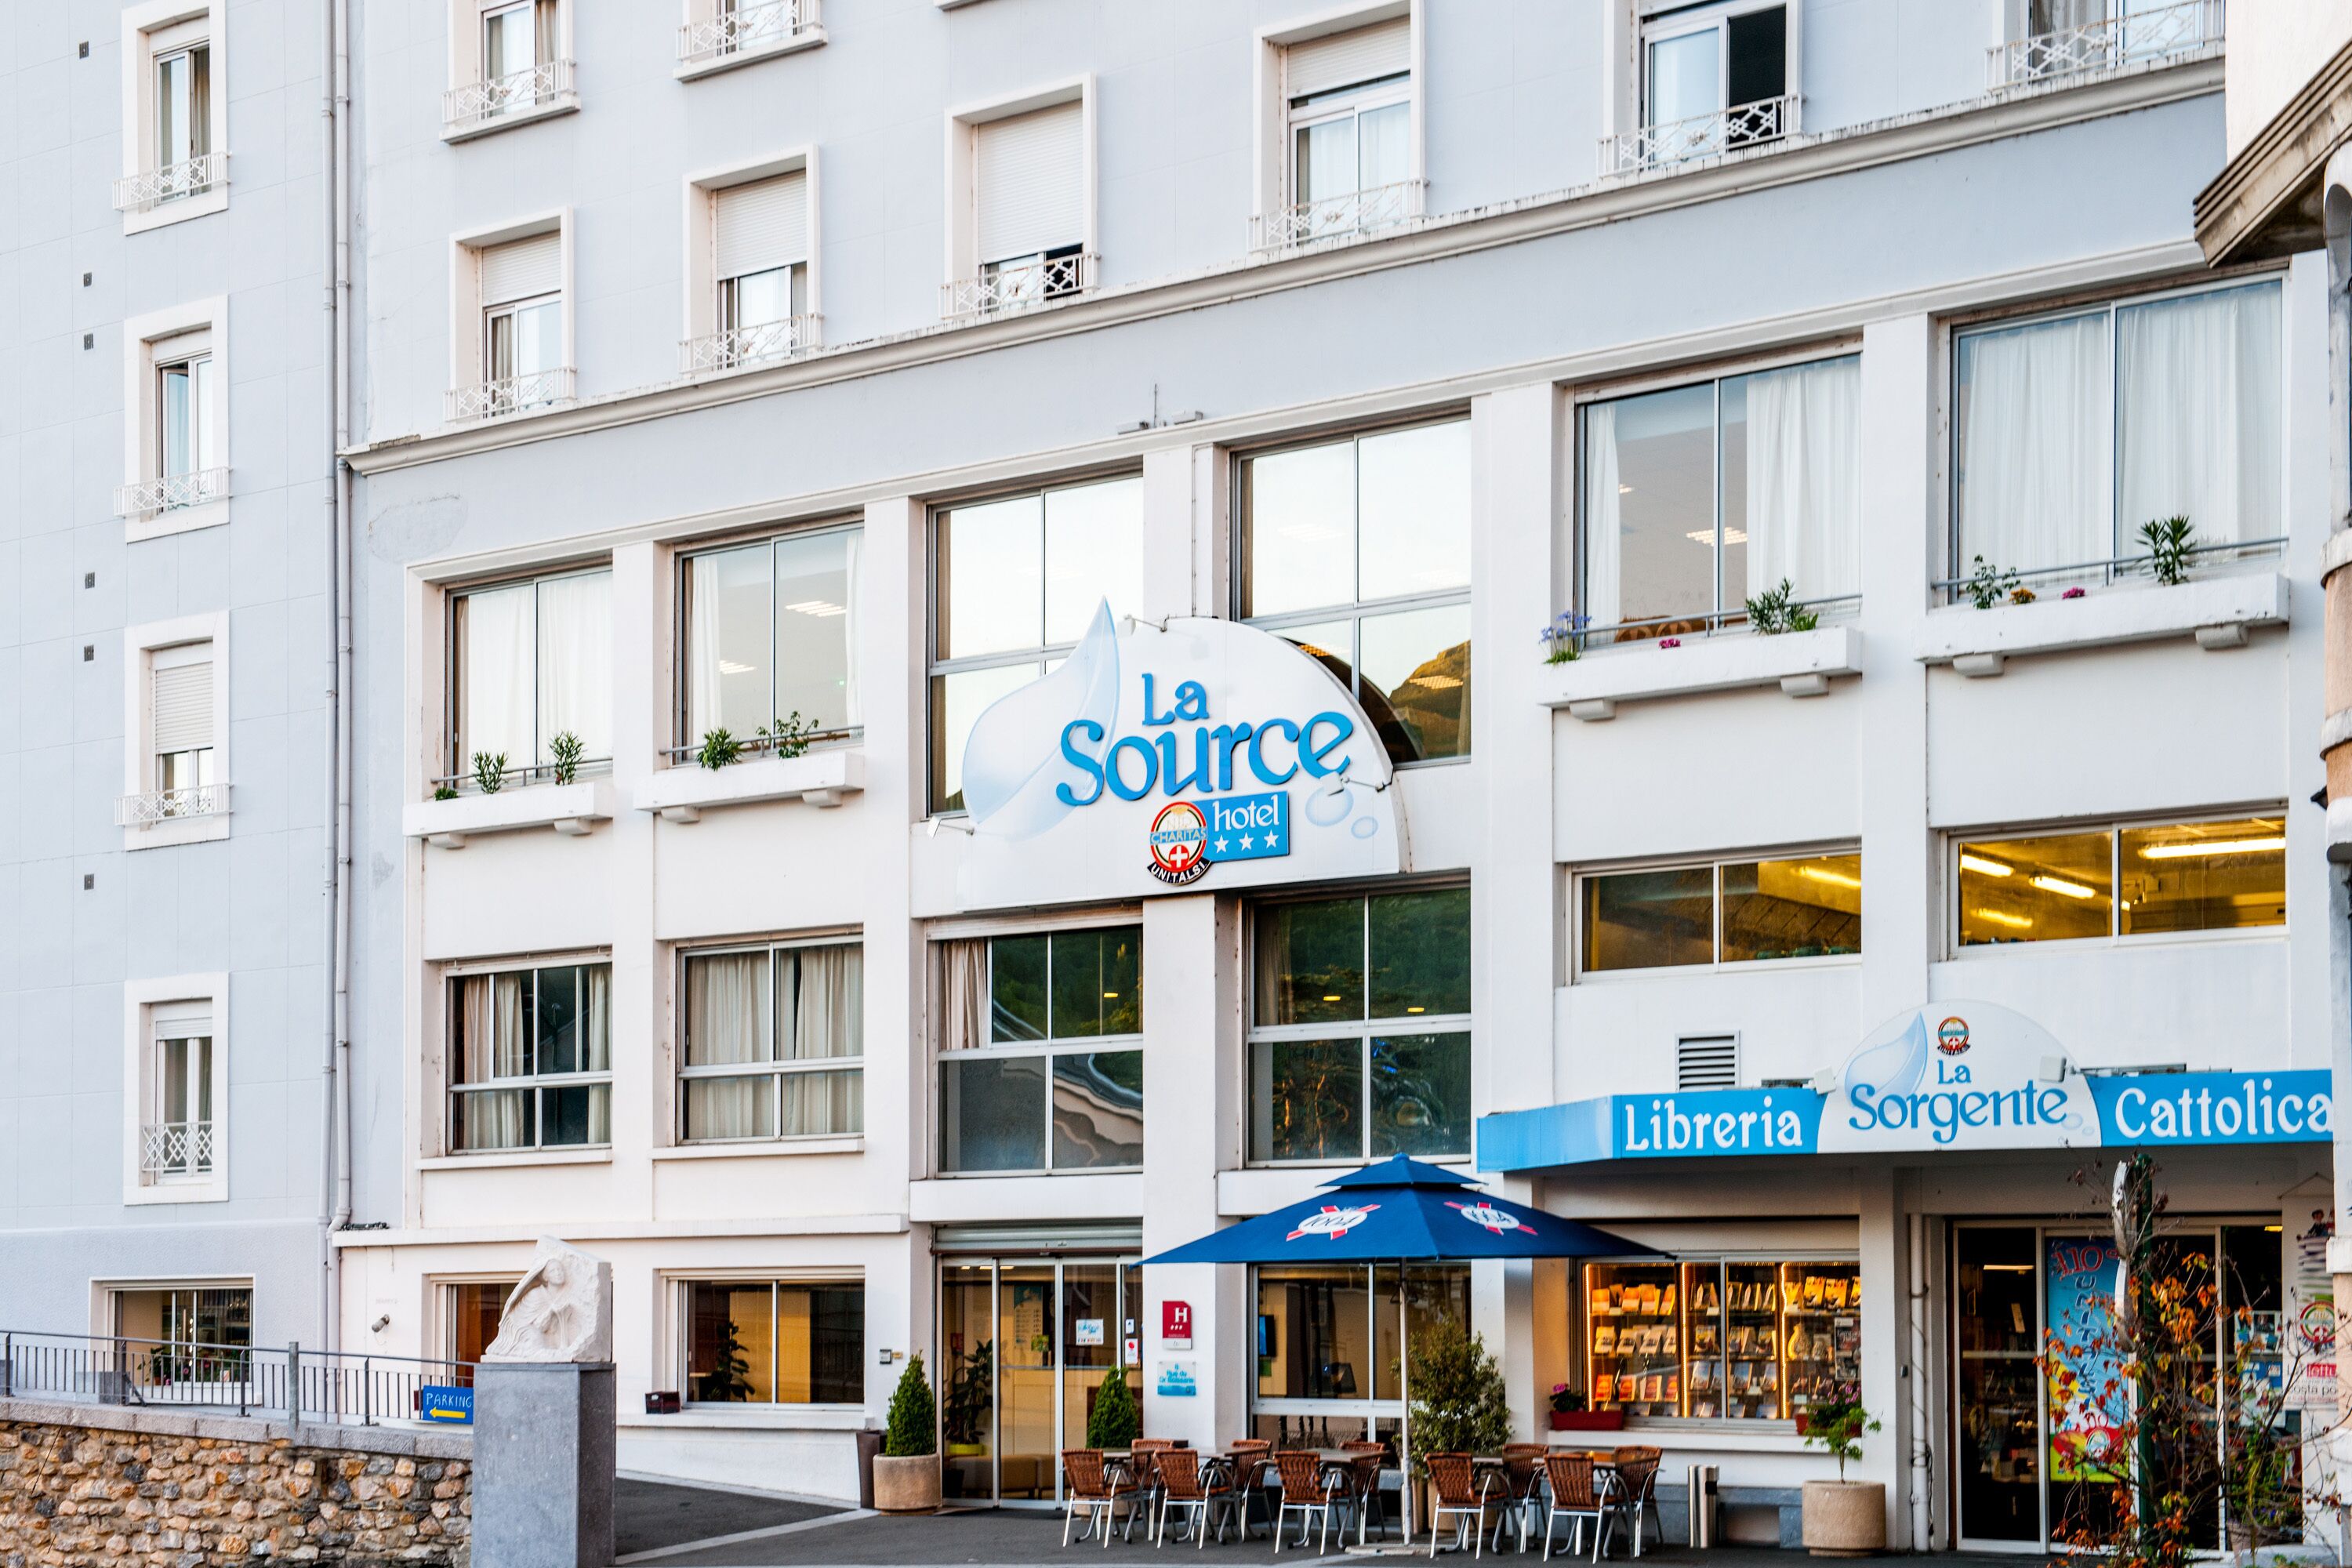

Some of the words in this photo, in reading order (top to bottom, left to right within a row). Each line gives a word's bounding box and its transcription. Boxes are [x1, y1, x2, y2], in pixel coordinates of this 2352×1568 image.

[1141, 673, 1209, 726] La
[1055, 711, 1354, 806] Source
[1212, 793, 1279, 832] hotel
[1151, 828, 1207, 844] CHARITAS
[1937, 1059, 1972, 1084] La
[1625, 1095, 1802, 1151] Libreria
[1849, 1080, 2068, 1144] Sorgente
[2115, 1078, 2334, 1138] Cattolica
[1174, 1307, 1188, 1323] H
[426, 1392, 472, 1408] PARKING
